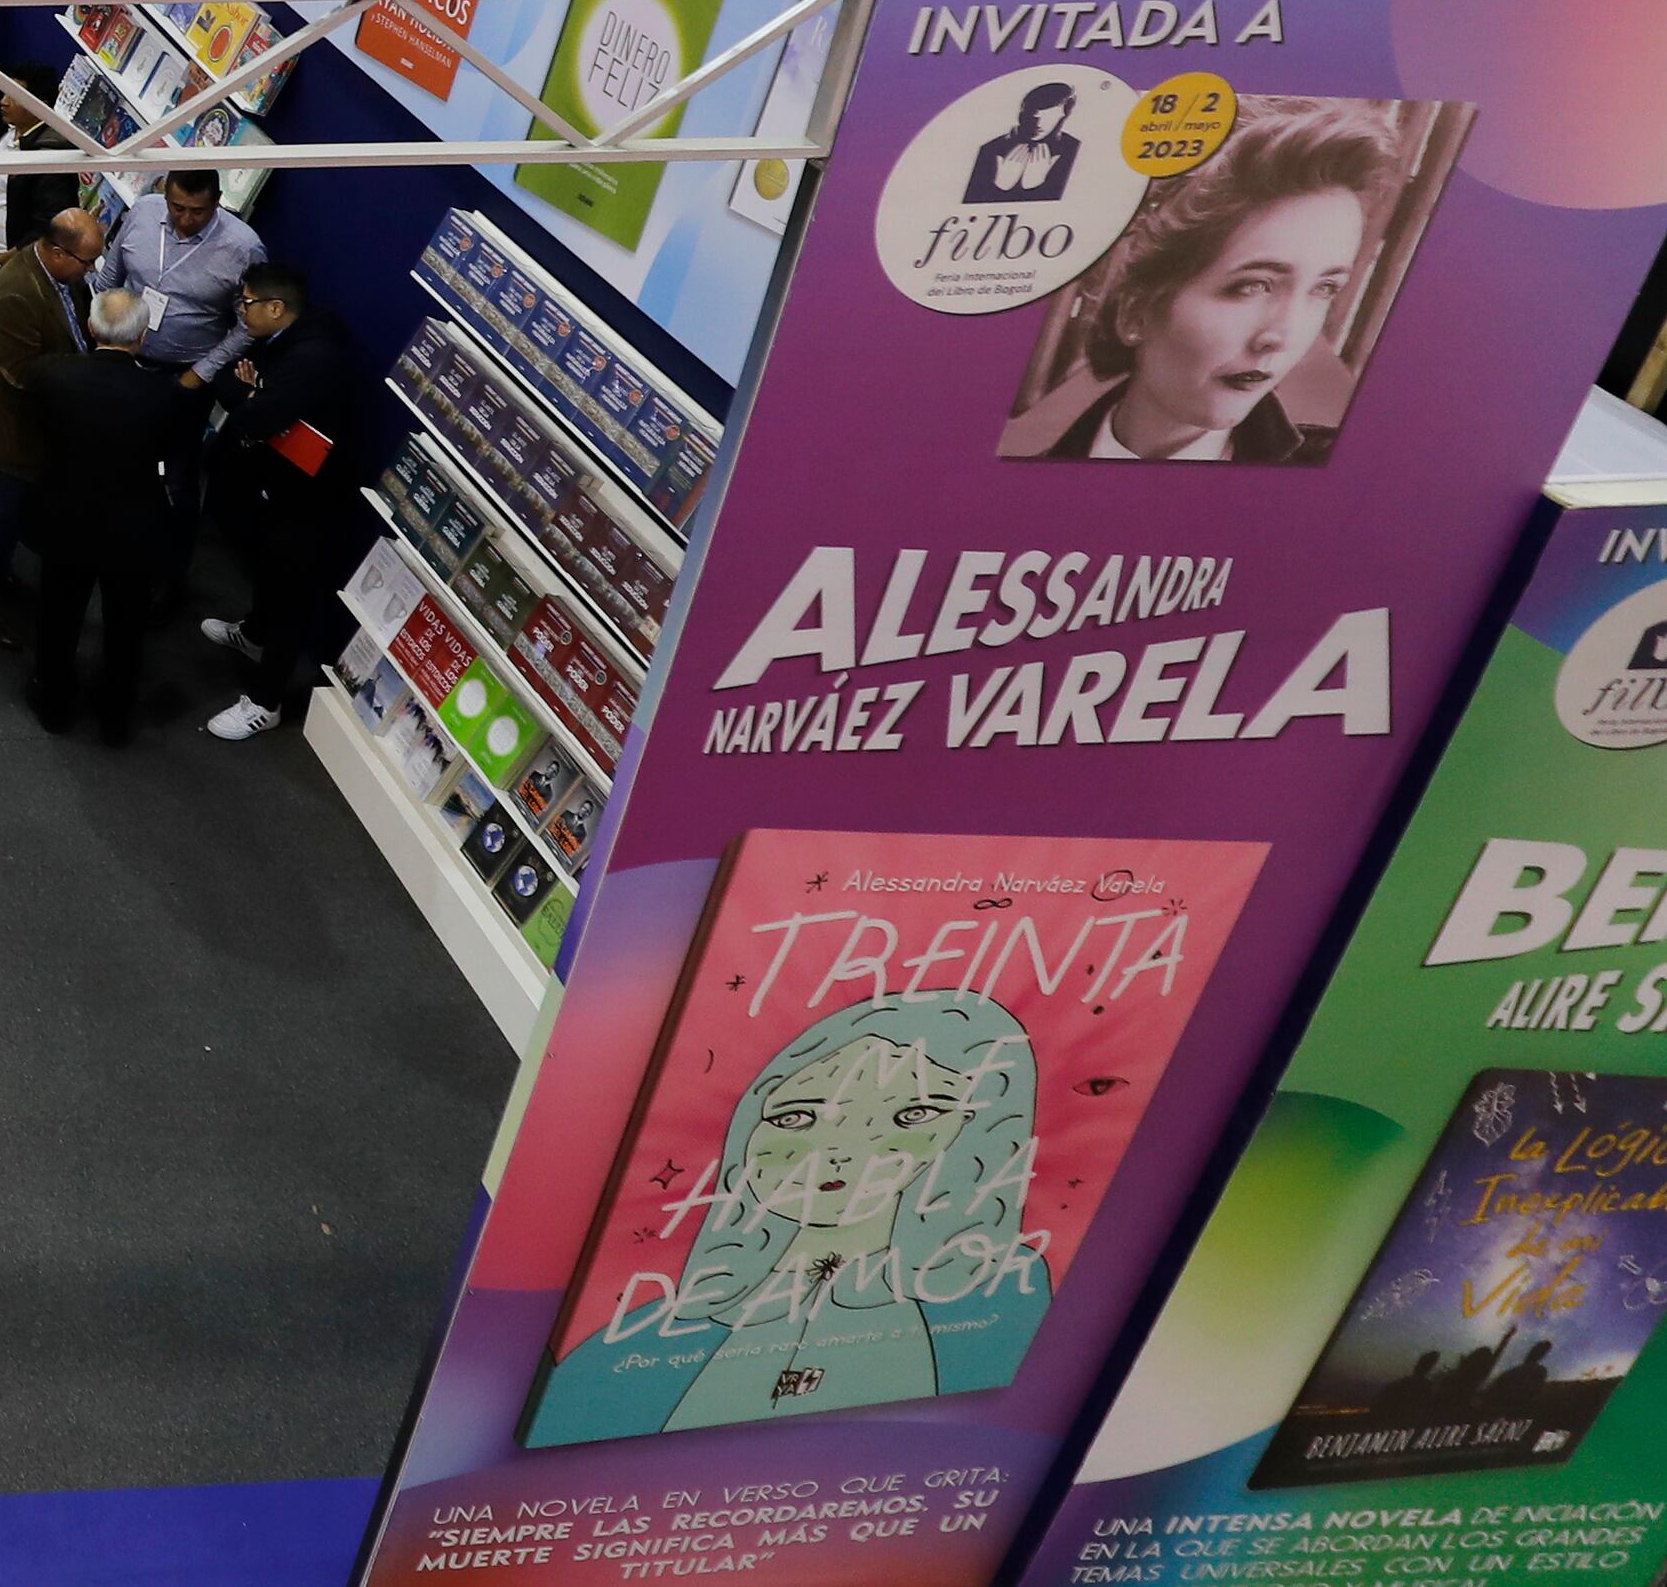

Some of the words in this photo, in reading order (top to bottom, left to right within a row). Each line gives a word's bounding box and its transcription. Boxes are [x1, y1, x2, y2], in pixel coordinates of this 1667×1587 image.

[599, 10, 673, 86] DINERO
[1139, 119, 1173, 133] abril
[1183, 120, 1221, 134] mayo
[1150, 93, 1178, 115] 18
[1137, 139, 1204, 160] 2023
[913, 214, 1075, 269] filbo
[711, 543, 1236, 693] ALESSANDRA
[700, 675, 928, 758] NARVÁEZ
[940, 604, 1393, 751] VARELA
[842, 869, 984, 893] Alessandra
[991, 871, 1088, 894] Narváez
[1097, 873, 1167, 894] Varela
[747, 909, 1189, 1018] TREINTA
[1485, 968, 1623, 1033] ALIRE
[658, 1134, 1041, 1240] HABLA
[602, 1269, 728, 1347] DE
[725, 1230, 1052, 1332] AMOR
[1305, 1429, 1413, 1461] BENJAMIN
[431, 1506, 496, 1526] UNA
[516, 1493, 642, 1521] NOVELA
[662, 1489, 703, 1510] EN
[721, 1479, 820, 1505] VERSO
[840, 1471, 908, 1495] QUE
[923, 1465, 1012, 1488] GRITA:
[591, 1517, 652, 1538] LAS
[670, 1493, 929, 1531] RECORDAREMOS.
[952, 1488, 1002, 1511] SU
[1092, 1518, 1155, 1538] UNA
[1165, 1514, 1315, 1537] INTENSA
[1321, 1506, 1465, 1531] NOVELA
[415, 1546, 554, 1574] MUERTE
[572, 1532, 736, 1564] SIGNIFICA
[756, 1523, 826, 1550] MÁS
[849, 1518, 918, 1544] QUE
[938, 1512, 989, 1534] UN
